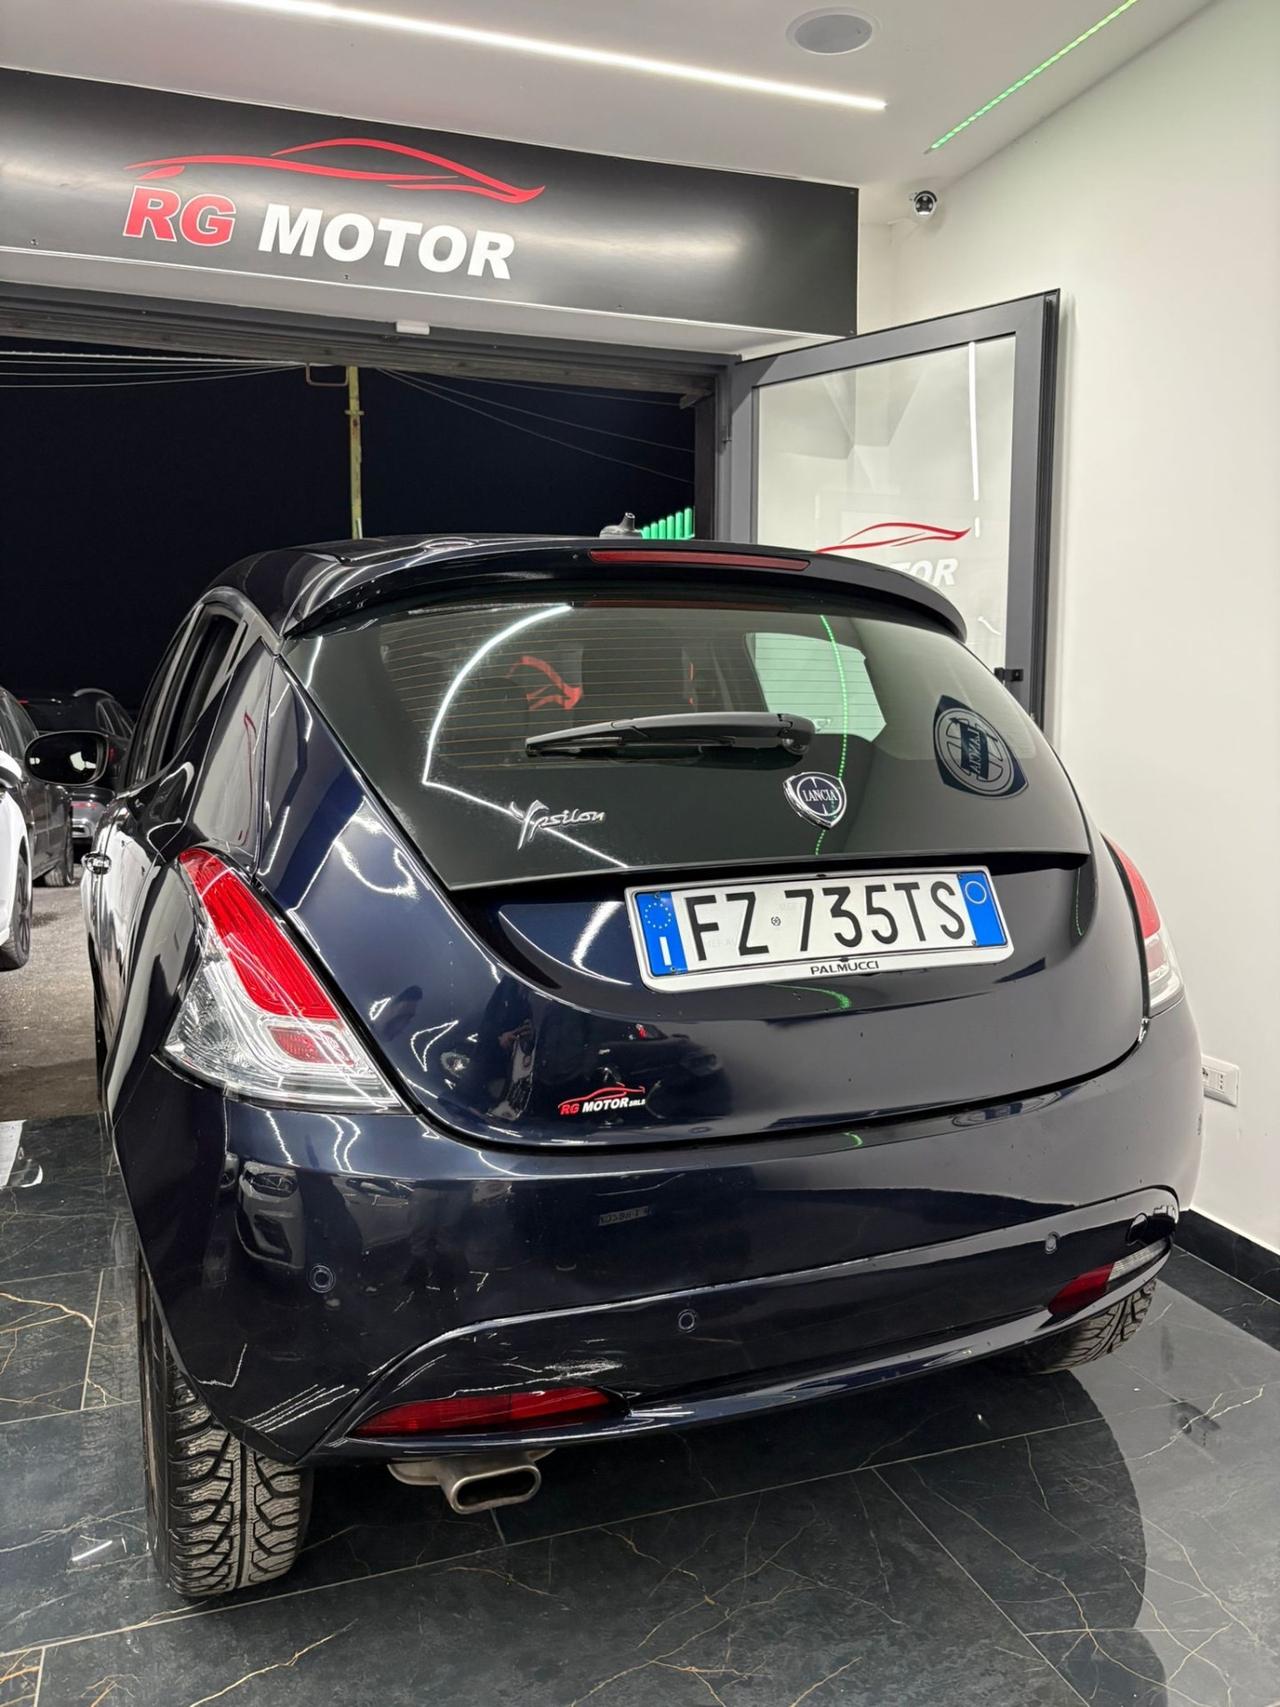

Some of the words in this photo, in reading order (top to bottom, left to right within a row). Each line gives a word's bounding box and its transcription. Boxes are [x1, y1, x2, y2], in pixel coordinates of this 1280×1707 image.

[122, 184, 237, 247] RG
[258, 203, 516, 280] MOTOR
[802, 788, 839, 802] LANCIA
[509, 799, 605, 851] Ypsilon
[684, 891, 770, 962] FZ
[784, 880, 966, 953] 735TS
[810, 960, 880, 975] PALMUCCI
[560, 1103, 580, 1115] RG
[582, 1097, 630, 1113] MOTOR
